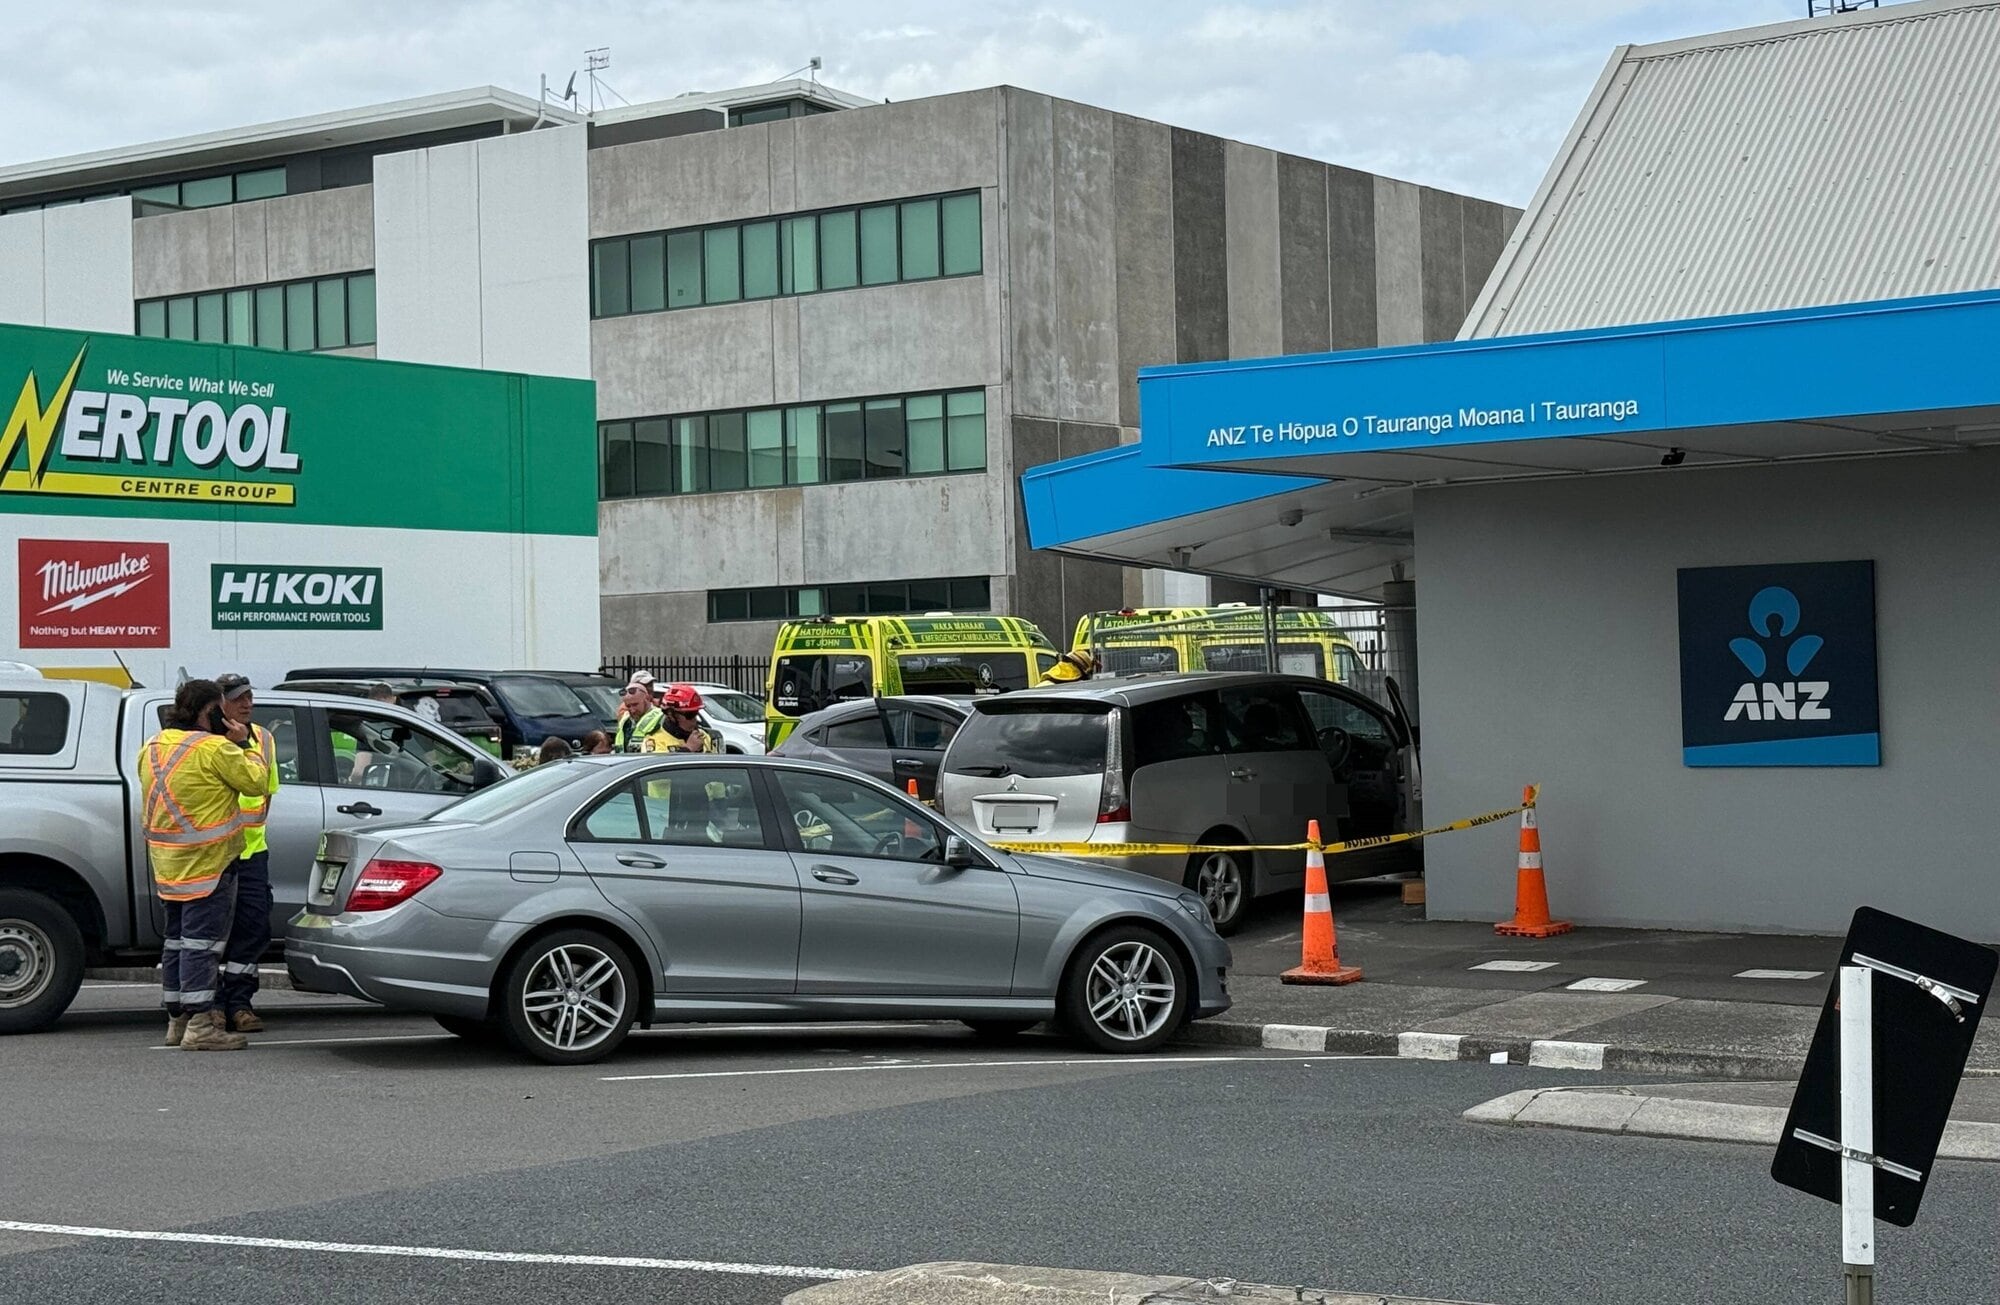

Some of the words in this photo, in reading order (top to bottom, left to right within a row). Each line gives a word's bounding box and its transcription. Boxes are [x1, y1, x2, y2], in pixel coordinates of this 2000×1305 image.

[107, 369, 129, 386] We
[132, 372, 183, 390] Service
[189, 377, 224, 394] What
[228, 380, 248, 396] We
[251, 382, 274, 398] Sell
[1207, 426, 1246, 447] ANZ
[1250, 425, 1274, 443] Te
[1279, 422, 1338, 444] Hōpua
[1342, 417, 1359, 436] O
[1363, 414, 1453, 435] Tauranga
[1459, 407, 1524, 427] Moana
[1541, 400, 1638, 421] Tauranga
[121, 480, 200, 496] CENTRE
[210, 485, 277, 499] GROUP
[217, 611, 241, 621] HIGH
[243, 612, 308, 622] PERFORMANCE
[310, 612, 341, 622] POWER
[343, 612, 370, 622] TOOLS
[30, 626, 69, 637] Nothing
[71, 626, 87, 635] but
[89, 626, 125, 635] HEAVY
[931, 622, 953, 630] WAKA
[800, 628, 821, 636] HATO
[920, 634, 961, 642] EMERGENCY
[962, 632, 1002, 641] AMBULANCE
[1723, 681, 1831, 721] ANZ
